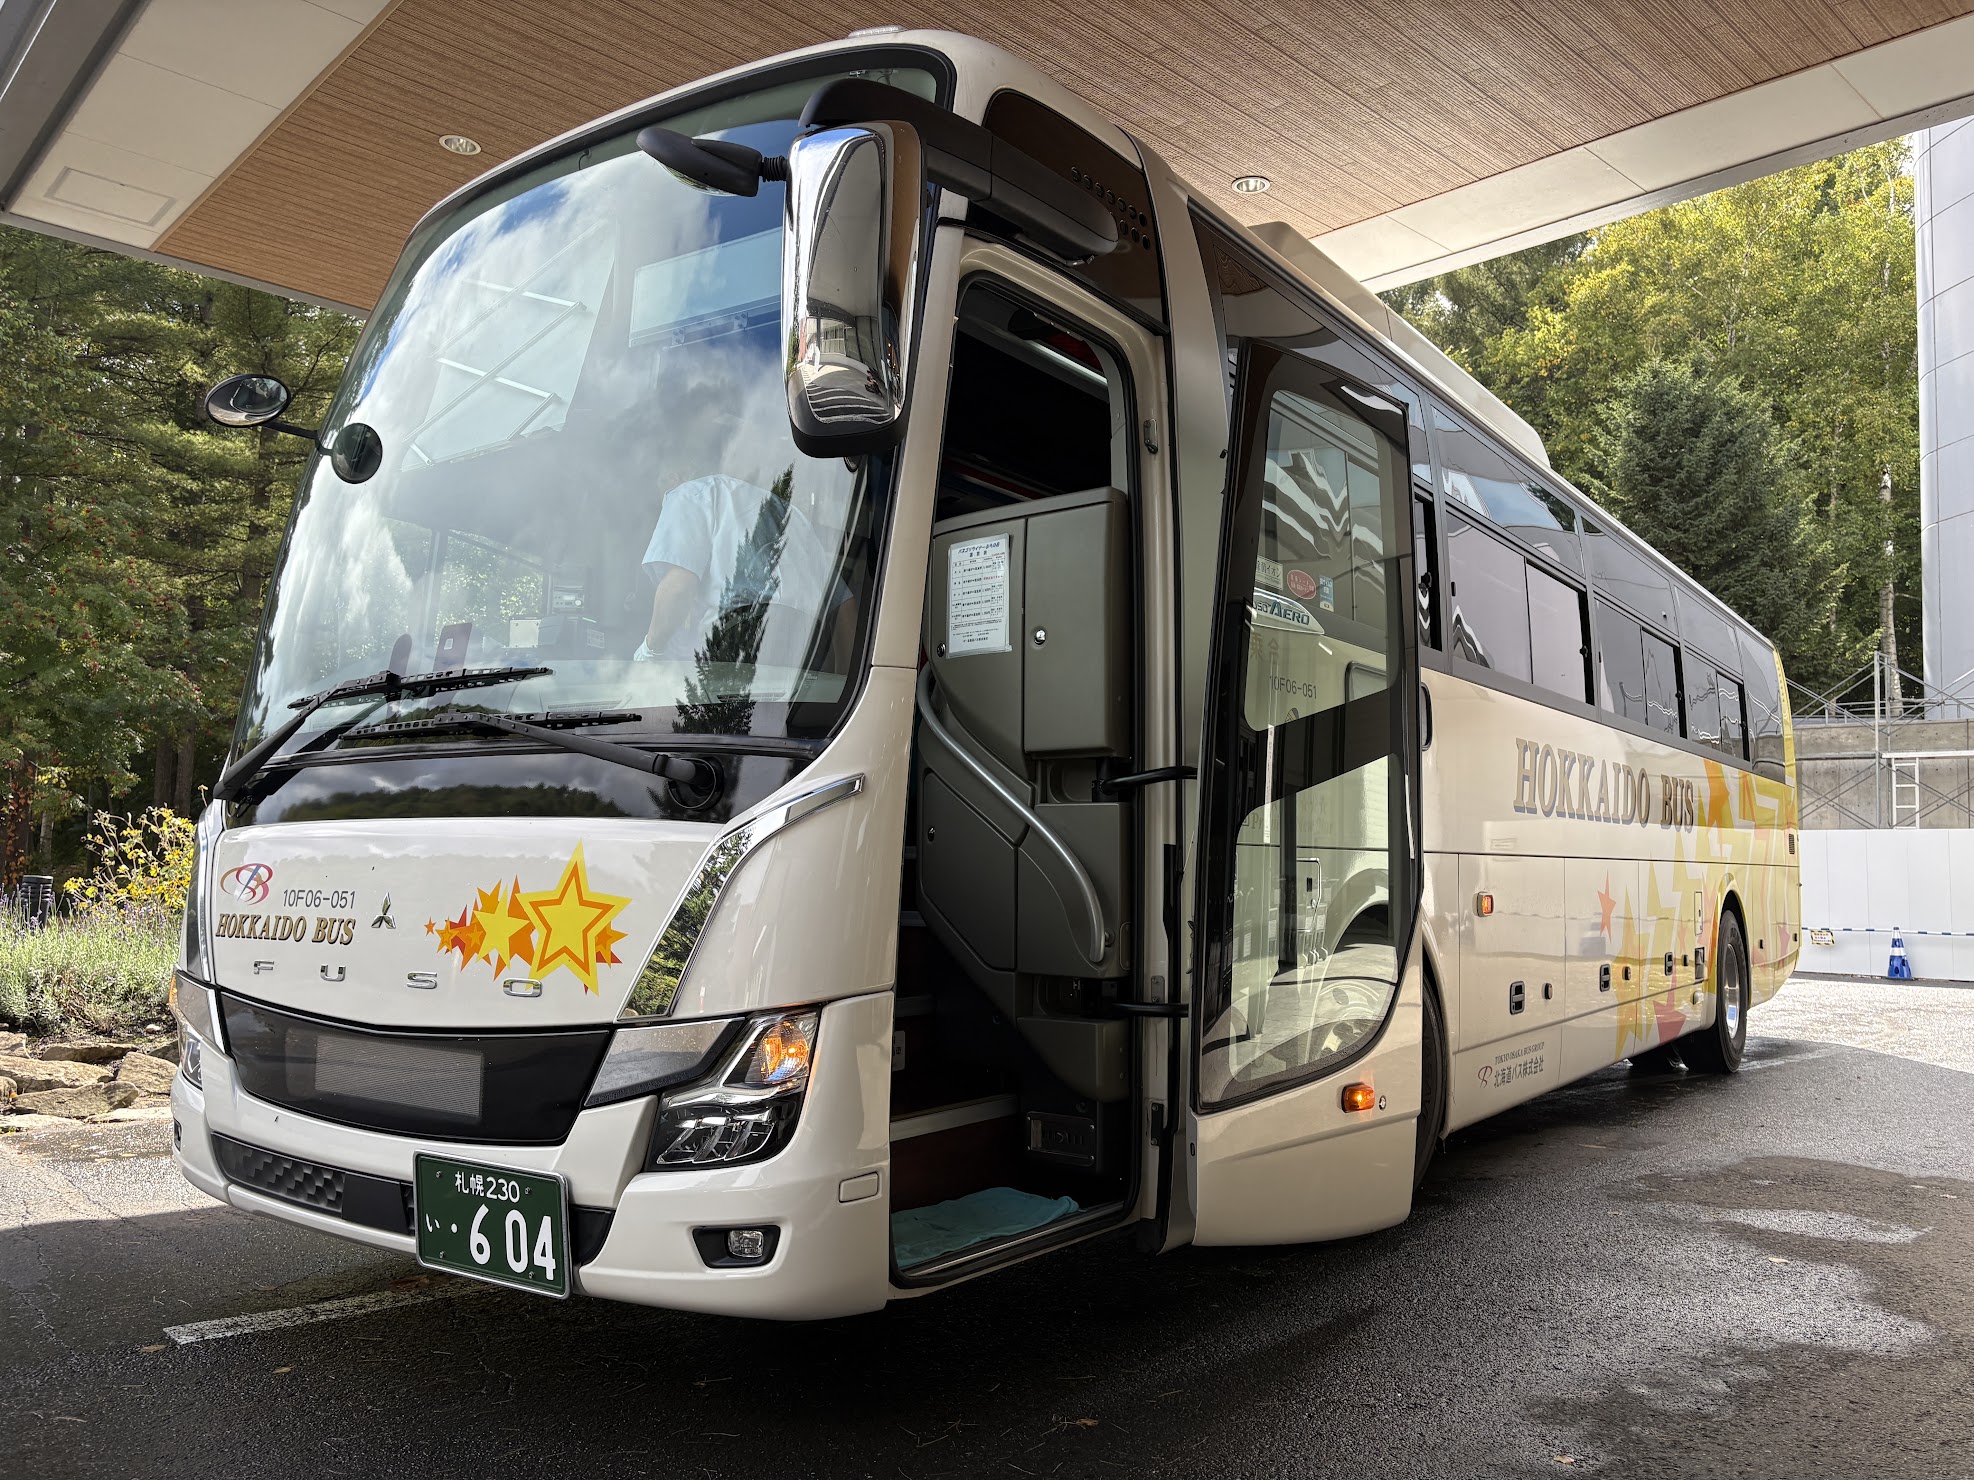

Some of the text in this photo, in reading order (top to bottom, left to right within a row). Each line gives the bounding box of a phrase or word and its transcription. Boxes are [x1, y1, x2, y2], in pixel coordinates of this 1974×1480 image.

[1269, 602, 1310, 626] AERO
[1270, 675, 1317, 699] 10F06-051
[1513, 737, 1694, 833] HOKKAIDO BUS
[282, 889, 355, 909] 10F06-051
[215, 913, 356, 945] HOKKAIDO BUS
[253, 960, 543, 998] FUSO
[1494, 1055, 1544, 1088] 北海道バス株式会社
